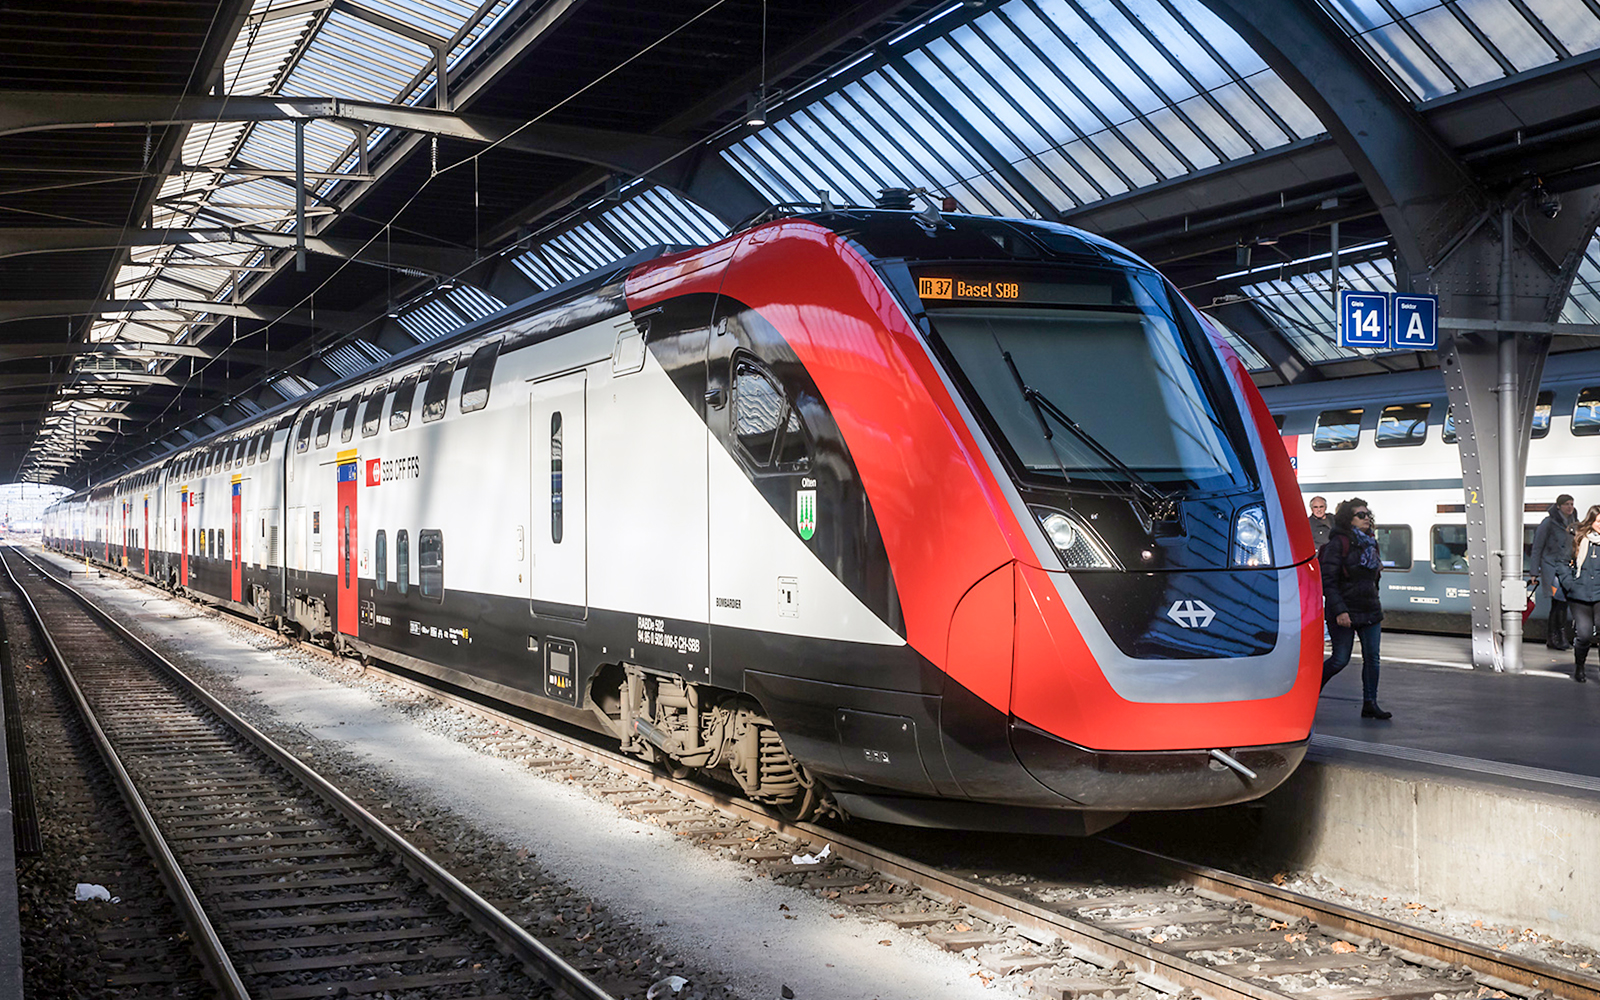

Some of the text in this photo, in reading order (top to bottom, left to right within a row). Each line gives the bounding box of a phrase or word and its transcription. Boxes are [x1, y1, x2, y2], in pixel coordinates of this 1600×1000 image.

[921, 280, 1019, 299] IR 37 Basel SBB
[1352, 309, 1381, 337] 14
[1405, 312, 1426, 339] A
[382, 460, 393, 481] SBB
[395, 458, 406, 480] CFF
[407, 455, 420, 478] FFS
[1290, 457, 1296, 469] 2
[801, 477, 817, 488] Olten
[1470, 491, 1478, 503] 2
[716, 597, 741, 609] BOMBARDIER
